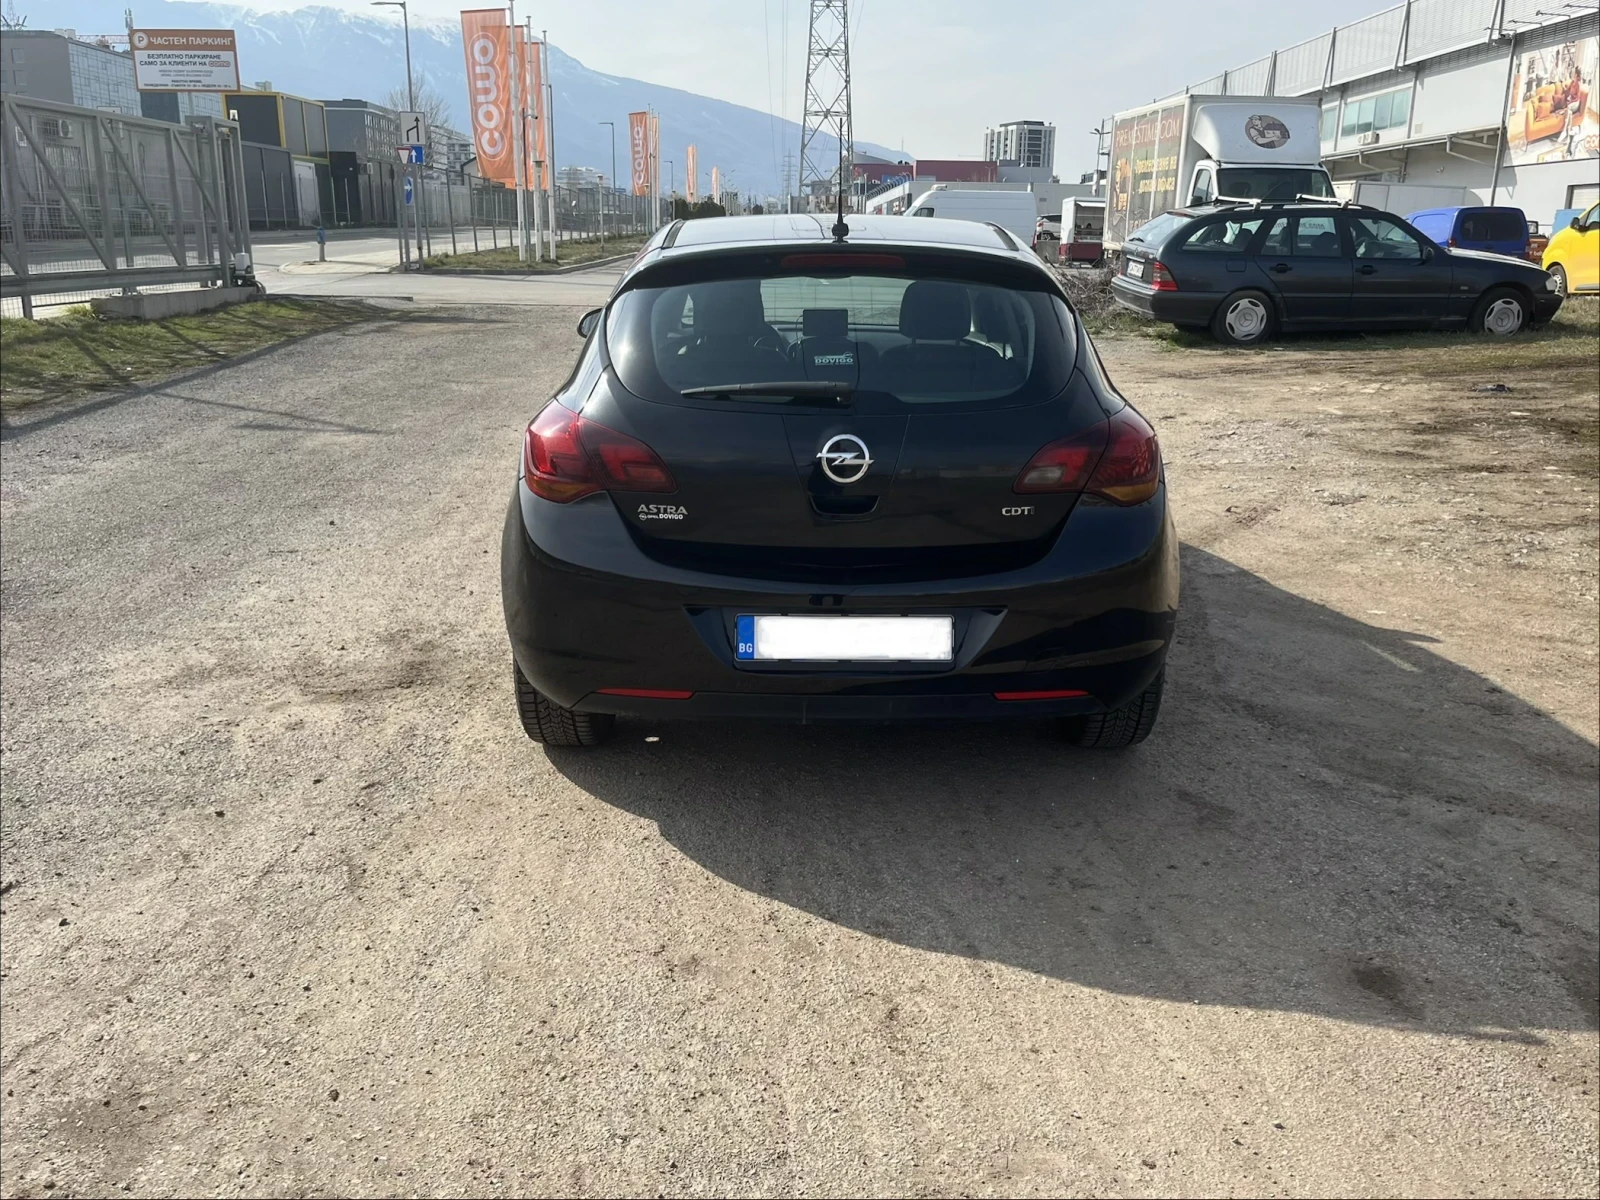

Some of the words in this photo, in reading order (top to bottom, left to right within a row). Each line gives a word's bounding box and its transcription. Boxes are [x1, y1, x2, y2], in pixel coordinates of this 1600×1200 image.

[150, 37, 186, 45] ЧАСТЕН
[189, 37, 233, 46] ПАРКИНГ
[473, 38, 502, 156] como
[637, 504, 689, 515] ASTRA
[738, 642, 753, 653] BG
